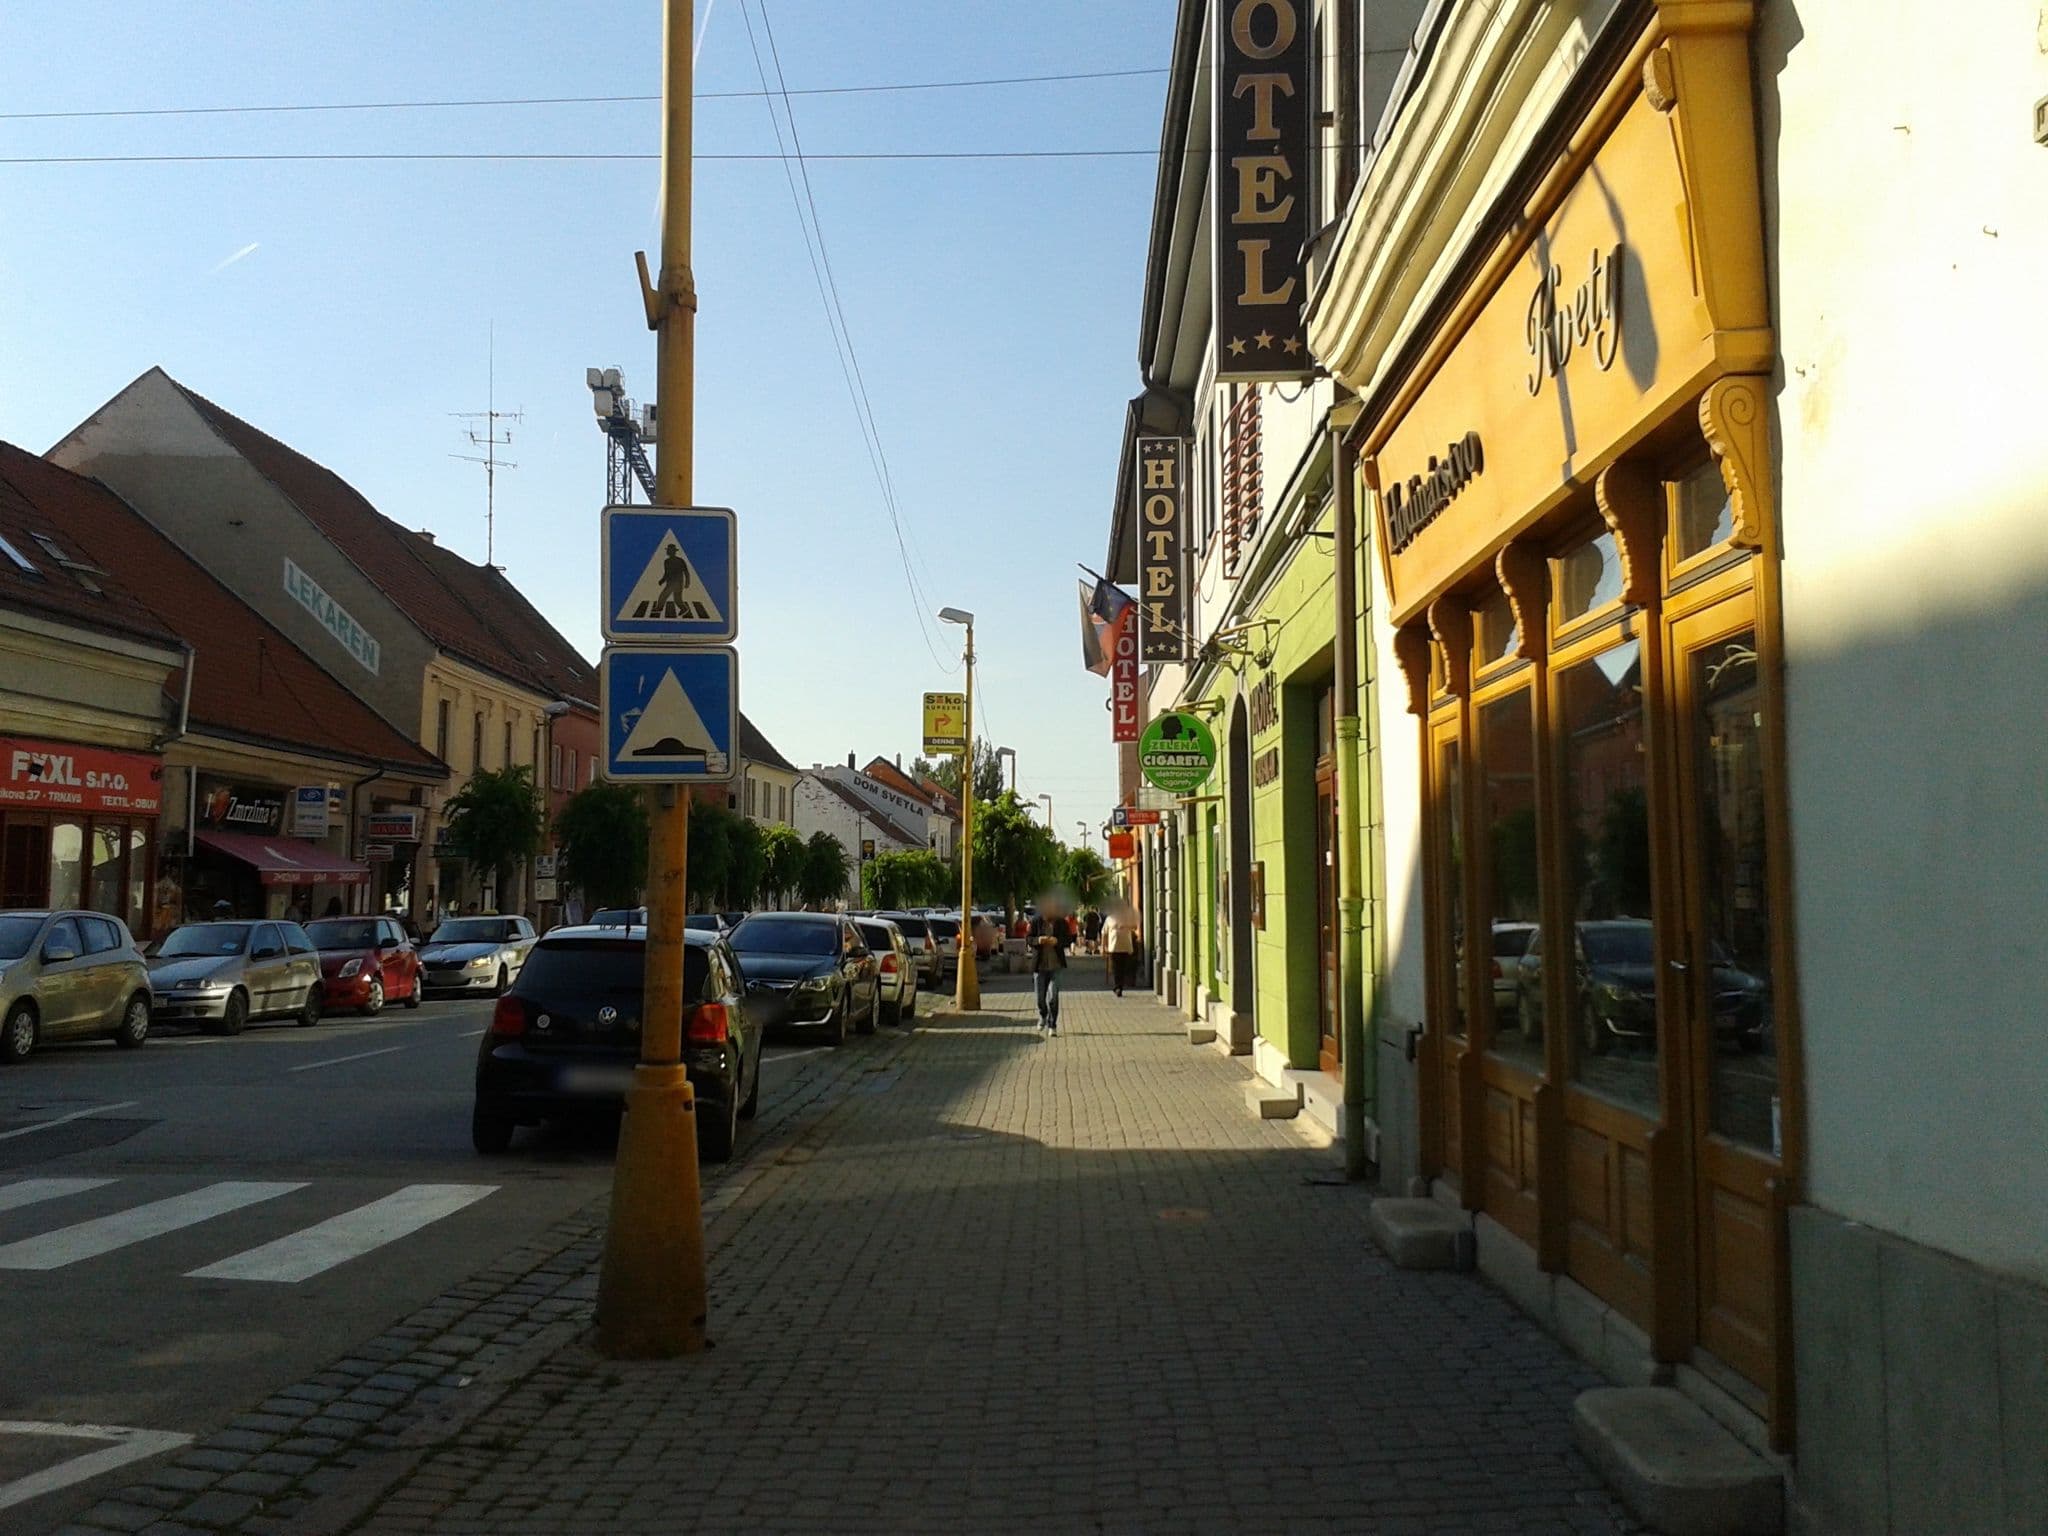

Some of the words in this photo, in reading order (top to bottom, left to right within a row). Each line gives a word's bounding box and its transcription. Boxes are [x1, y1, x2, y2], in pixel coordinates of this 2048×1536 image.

[1525, 243, 1625, 397] Kvety
[1144, 459, 1175, 633] HOTEL
[1149, 737, 1200, 752] ZELENÁ
[1143, 755, 1209, 766] CIGARETA
[86, 771, 129, 790] s.r.o.
[26, 789, 41, 801] 37
[854, 776, 879, 795] DOM
[881, 789, 924, 817] SVETLA
[1115, 811, 1125, 824] P
